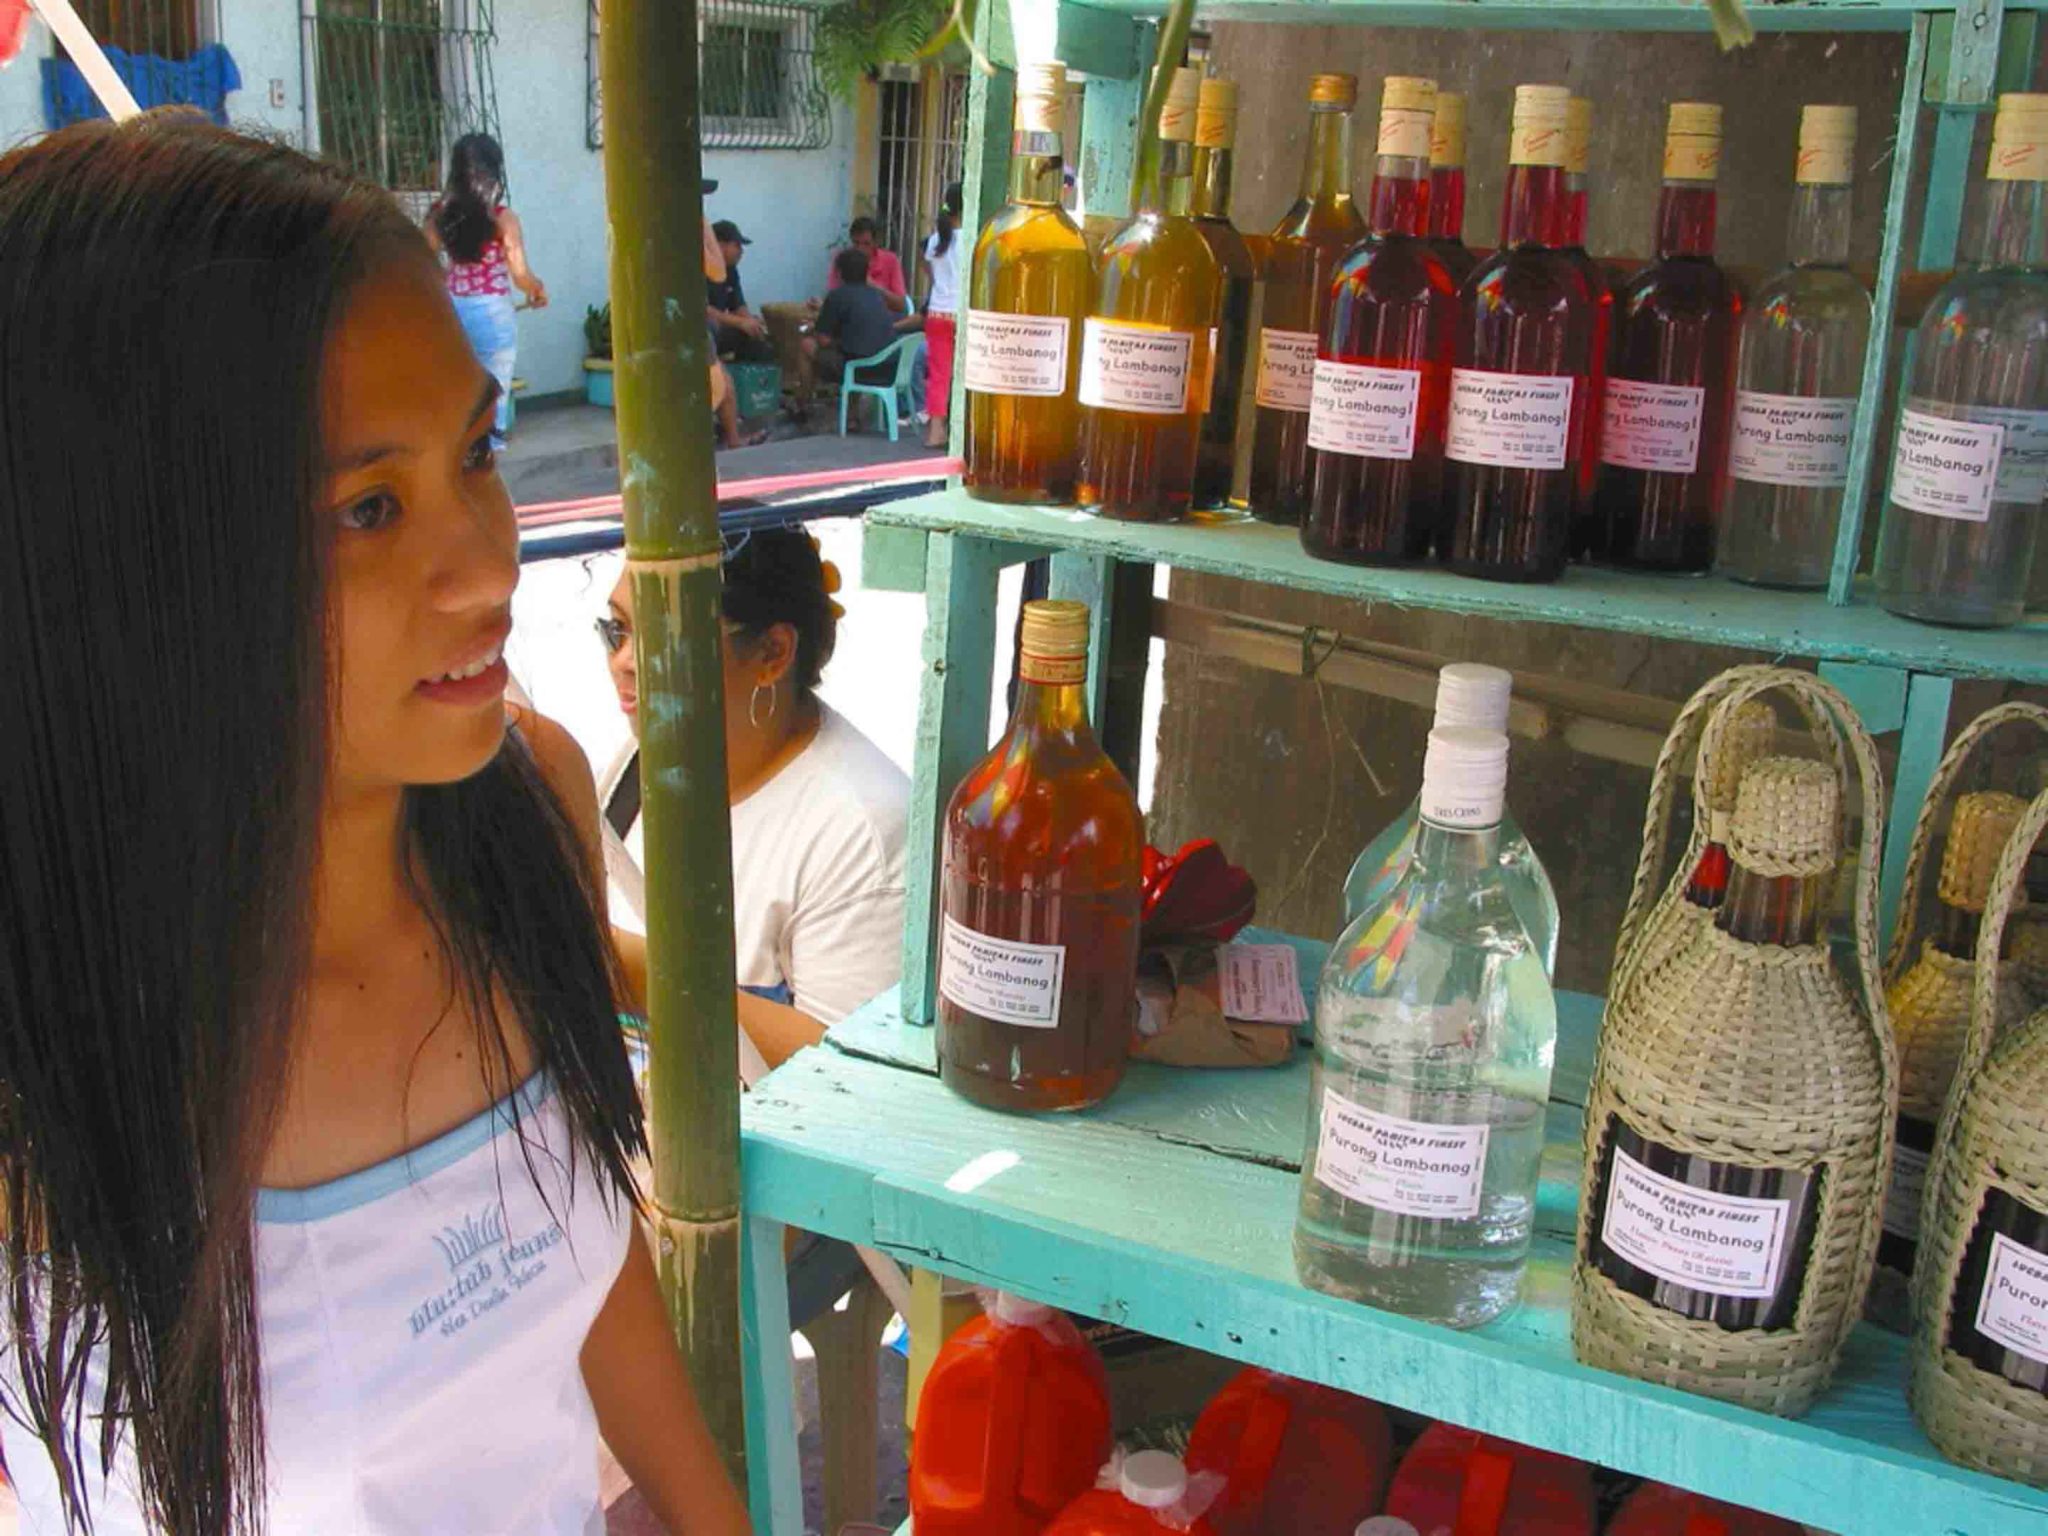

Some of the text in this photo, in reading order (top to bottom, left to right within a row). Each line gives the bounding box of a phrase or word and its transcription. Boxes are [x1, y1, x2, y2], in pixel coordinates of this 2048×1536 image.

[991, 344, 1058, 361] Lambanog
[1112, 357, 1182, 377] Lambanog
[1337, 398, 1408, 417] Lambanog
[1491, 404, 1562, 426] Lambanog
[1623, 412, 1691, 433] Lambanog
[1775, 425, 1848, 446] Lambanog
[1908, 449, 1985, 477] Lambanog
[977, 965, 1050, 991] Lambanog
[1328, 1126, 1472, 1177] Purong Lambanog
[1615, 1188, 1665, 1232] Purong
[1668, 1218, 1765, 1254] Lambanog
